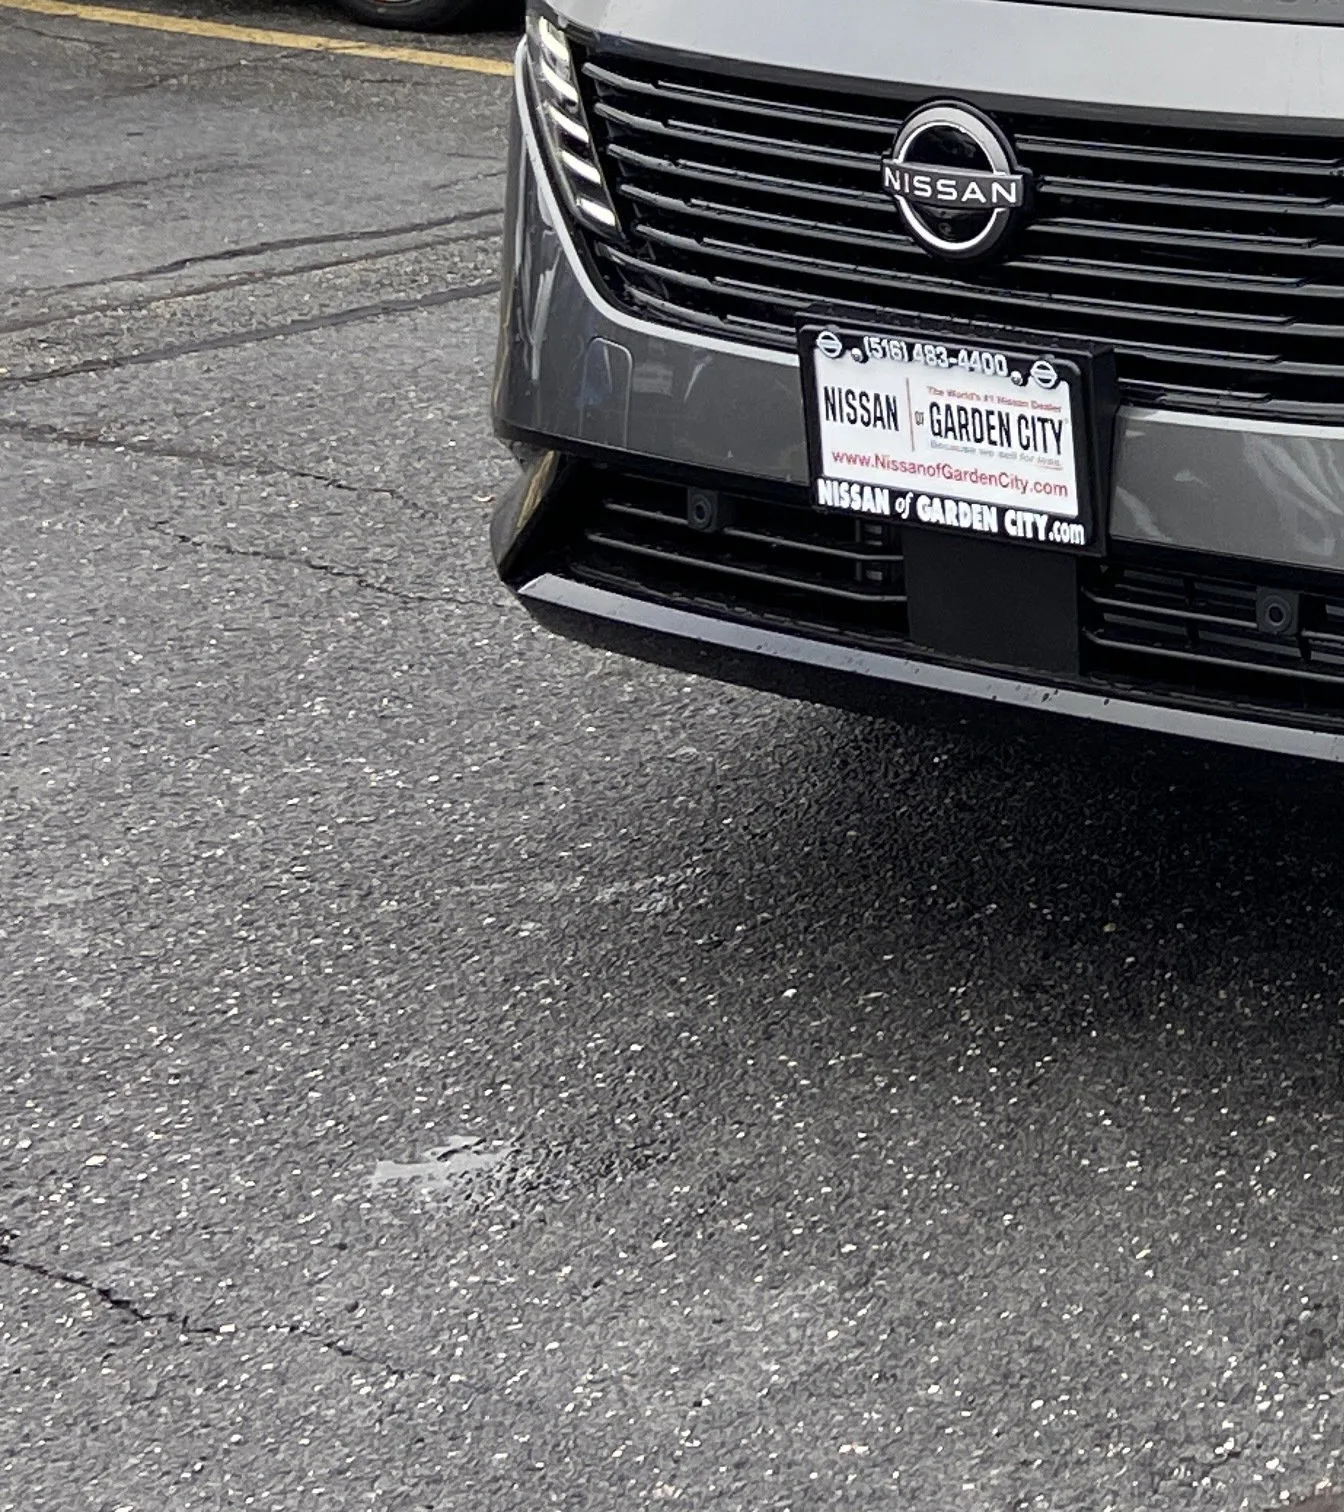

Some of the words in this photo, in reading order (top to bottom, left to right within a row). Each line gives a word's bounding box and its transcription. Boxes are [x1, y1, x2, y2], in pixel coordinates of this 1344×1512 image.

[884, 166, 1017, 204] NISSAN
[863, 336, 908, 362] (516)
[912, 343, 1009, 377] 483-4400
[823, 385, 900, 432] NISSAN
[929, 401, 1012, 448] GARDEN
[1017, 413, 1063, 456] CITY
[832, 449, 1069, 497] www.NissanofGardenCity.com
[817, 478, 891, 515] NISSAN
[895, 491, 914, 520] of
[915, 494, 999, 533] GARDEN
[1004, 509, 1085, 546] CITY.com
